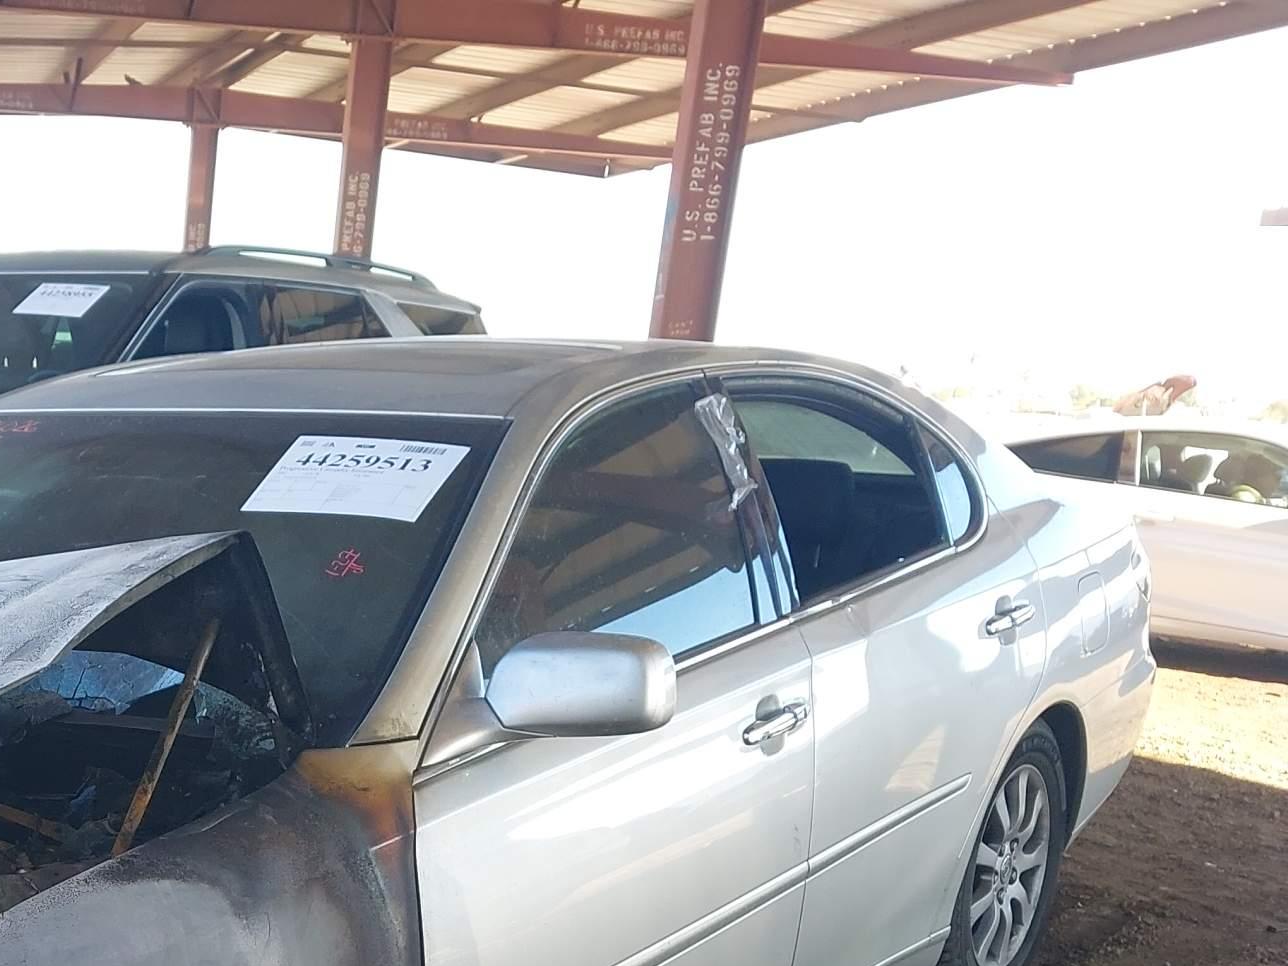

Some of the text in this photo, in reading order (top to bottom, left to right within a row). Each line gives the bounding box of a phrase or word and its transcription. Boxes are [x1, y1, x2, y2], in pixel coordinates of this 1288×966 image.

[680, 62, 723, 242] U.S. PREFAB INC.
[700, 64, 741, 241] 1-866-799-0969
[295, 452, 432, 473] 44259513
